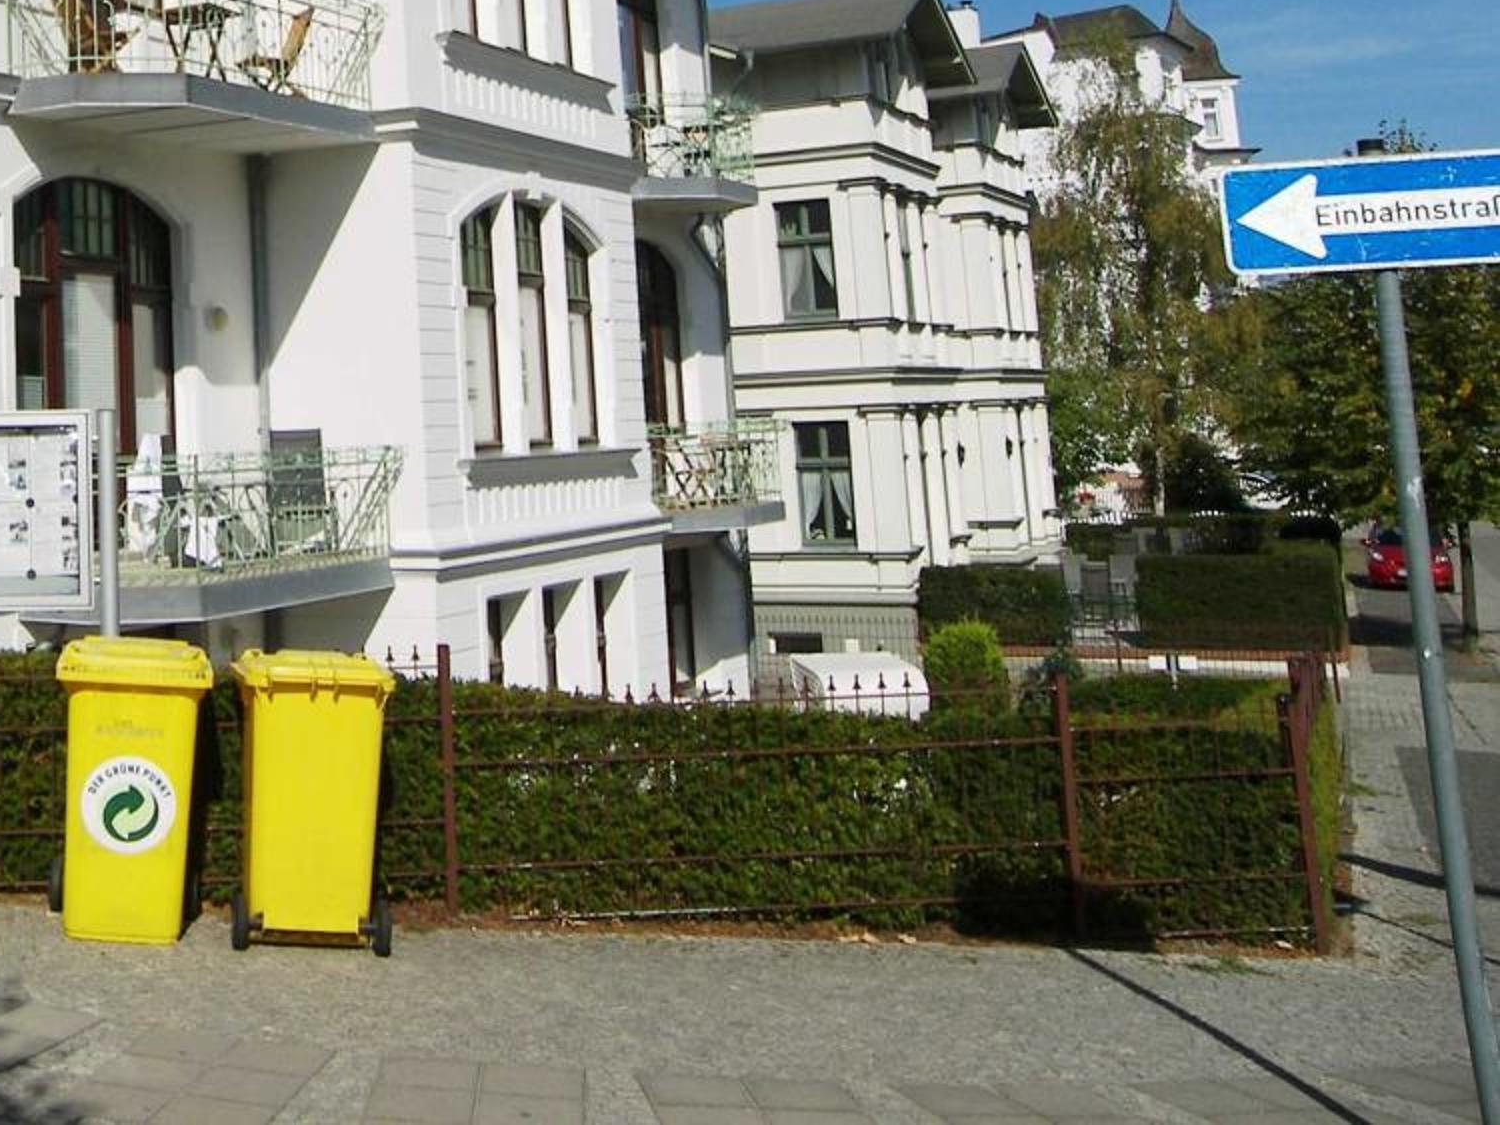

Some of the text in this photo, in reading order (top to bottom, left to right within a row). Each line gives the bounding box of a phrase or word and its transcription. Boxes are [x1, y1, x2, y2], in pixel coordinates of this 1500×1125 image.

[88, 763, 172, 797] DER GRÜNE PUNKT
